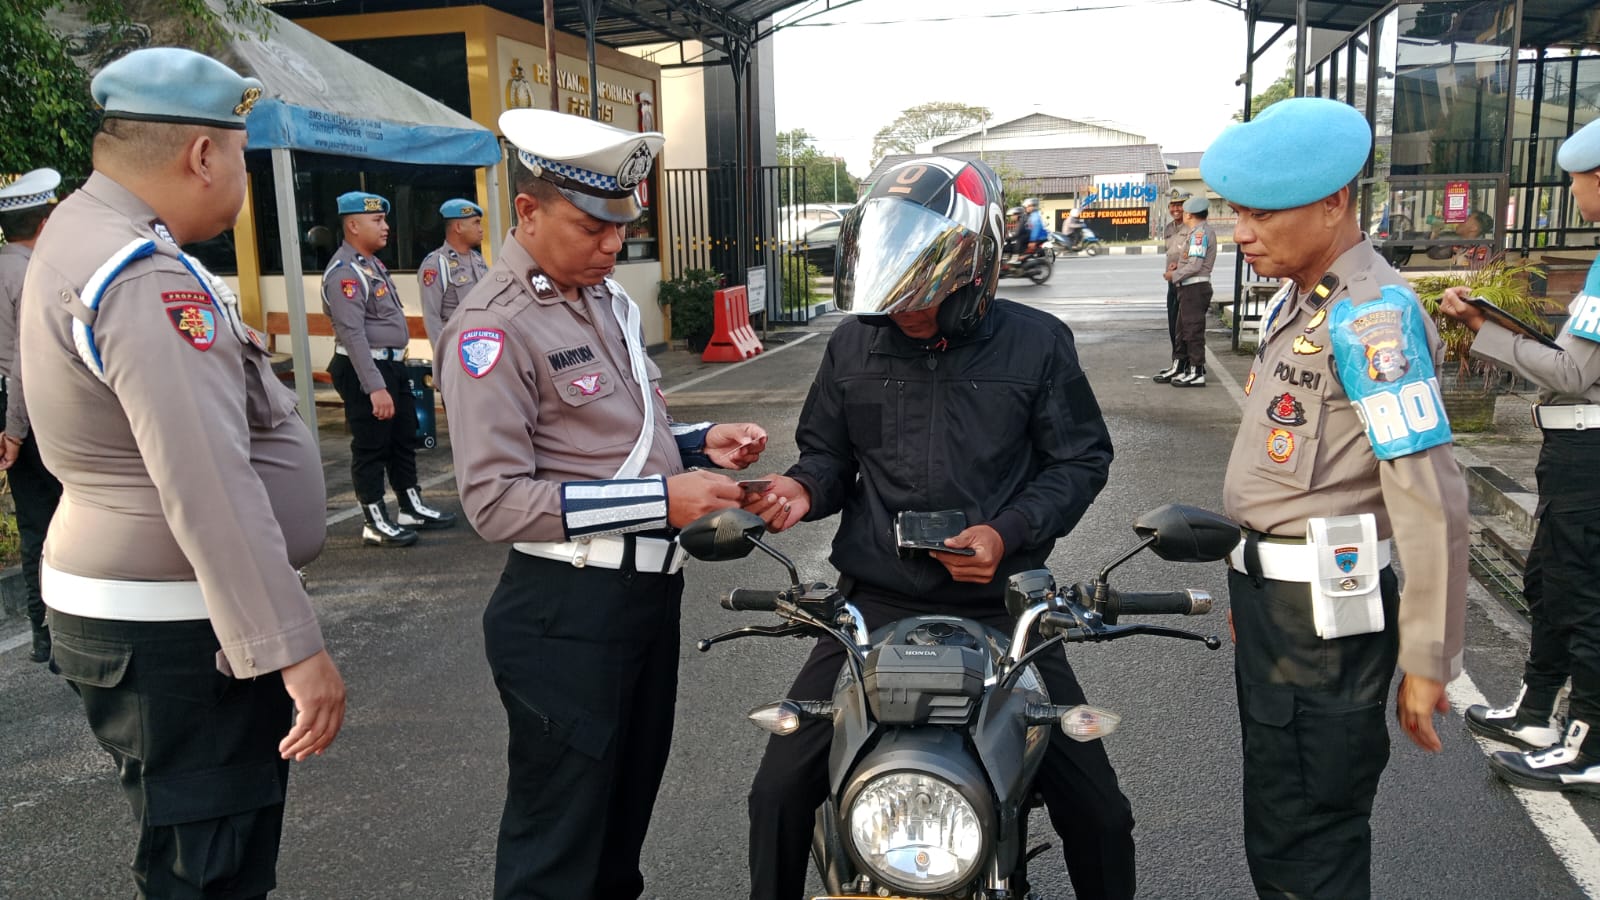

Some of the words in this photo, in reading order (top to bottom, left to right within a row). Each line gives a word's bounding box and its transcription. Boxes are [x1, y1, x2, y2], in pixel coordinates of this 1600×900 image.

[1102, 182, 1157, 202] bulog
[1097, 210, 1147, 218] PERGUDANGAN
[1274, 361, 1321, 390] POLRI
